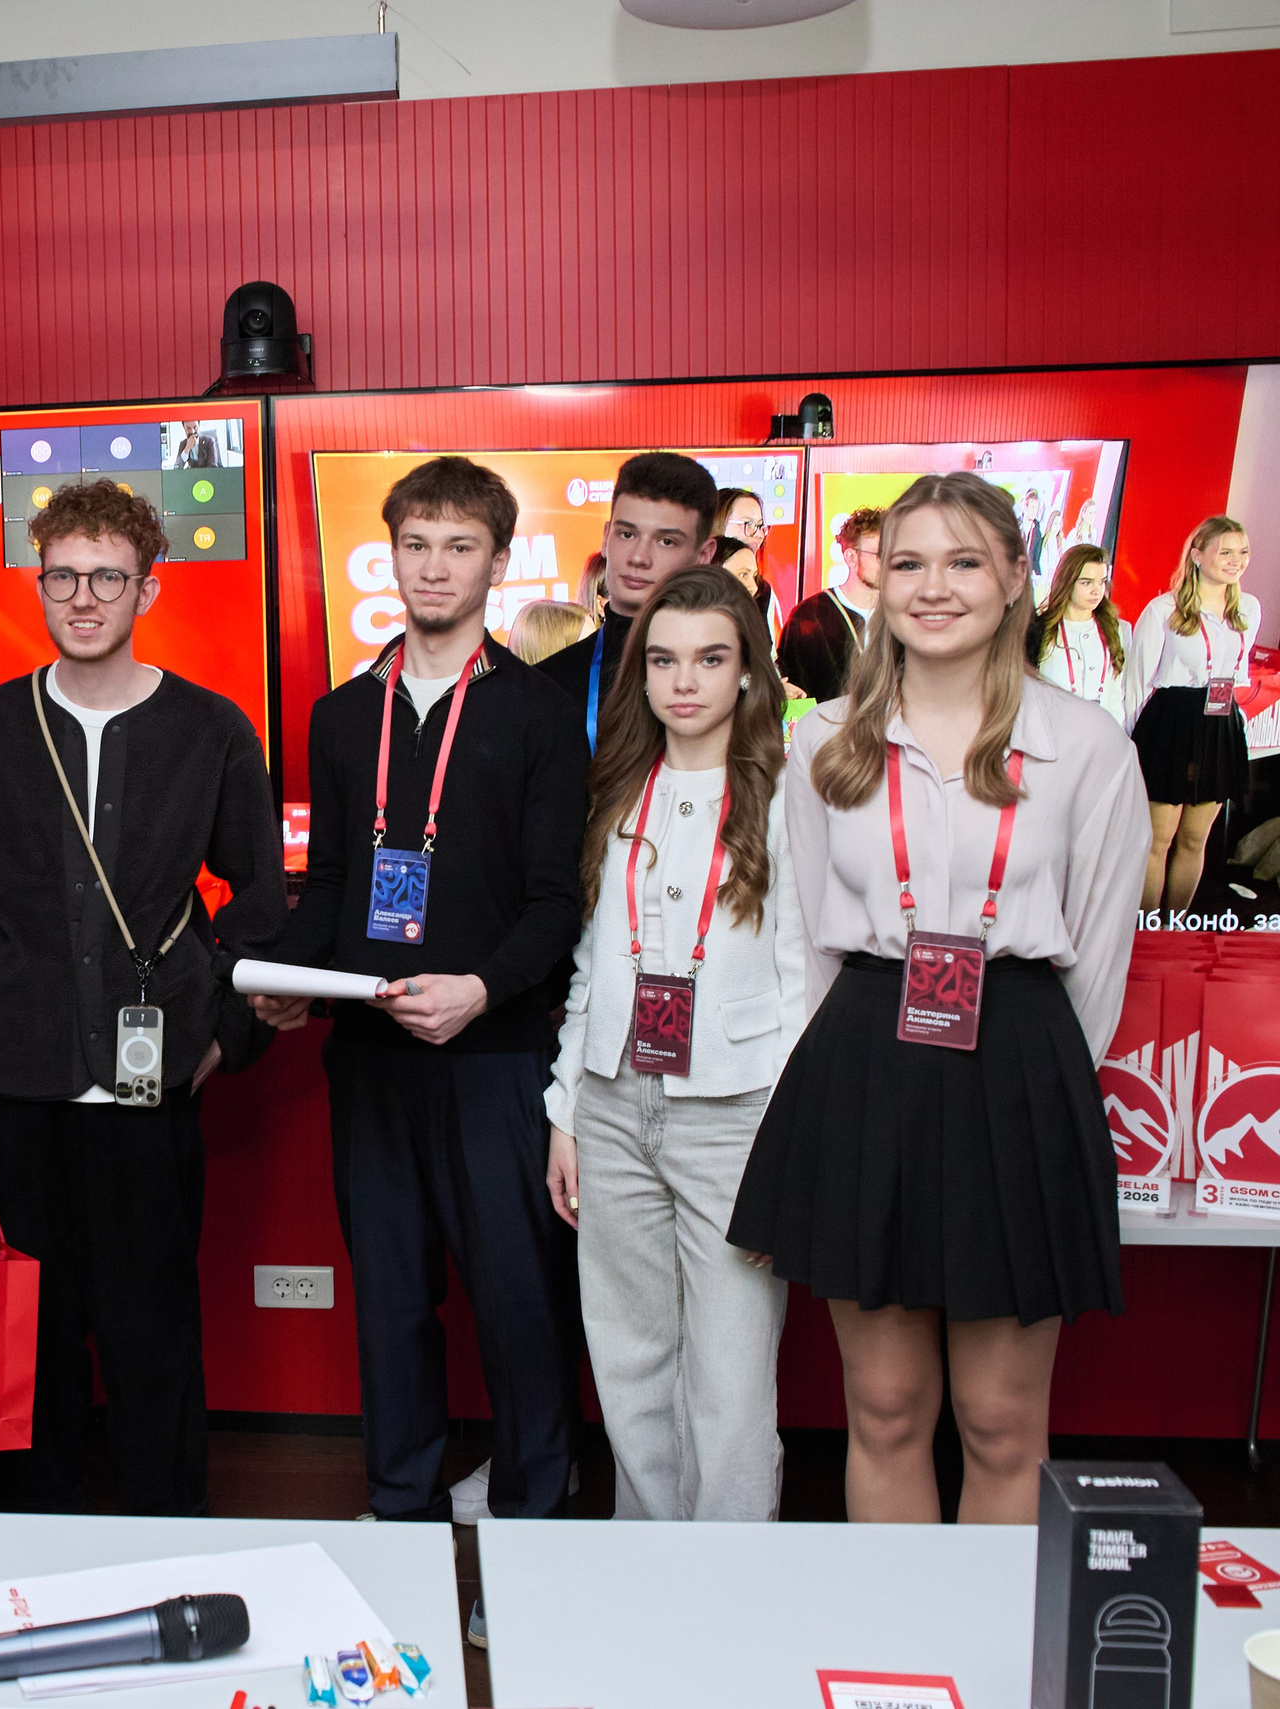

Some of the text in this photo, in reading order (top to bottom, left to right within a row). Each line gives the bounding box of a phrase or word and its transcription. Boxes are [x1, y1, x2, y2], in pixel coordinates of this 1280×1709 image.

[198, 534, 211, 542] ТЯ
[1169, 908, 1245, 932] Конф.
[906, 1014, 951, 1027] Акимова
[907, 1007, 961, 1021] Екатерина
[636, 1046, 677, 1058] Алексеева
[1134, 1182, 1159, 1191] LAB
[1230, 1186, 1269, 1197] GSOM
[1123, 1191, 1159, 1202] 2026
[1202, 1184, 1218, 1204] 3
[1077, 1475, 1159, 1488] Fashion
[1089, 1529, 1136, 1545] TRAVEL
[1089, 1543, 1148, 1558] TUMBLER
